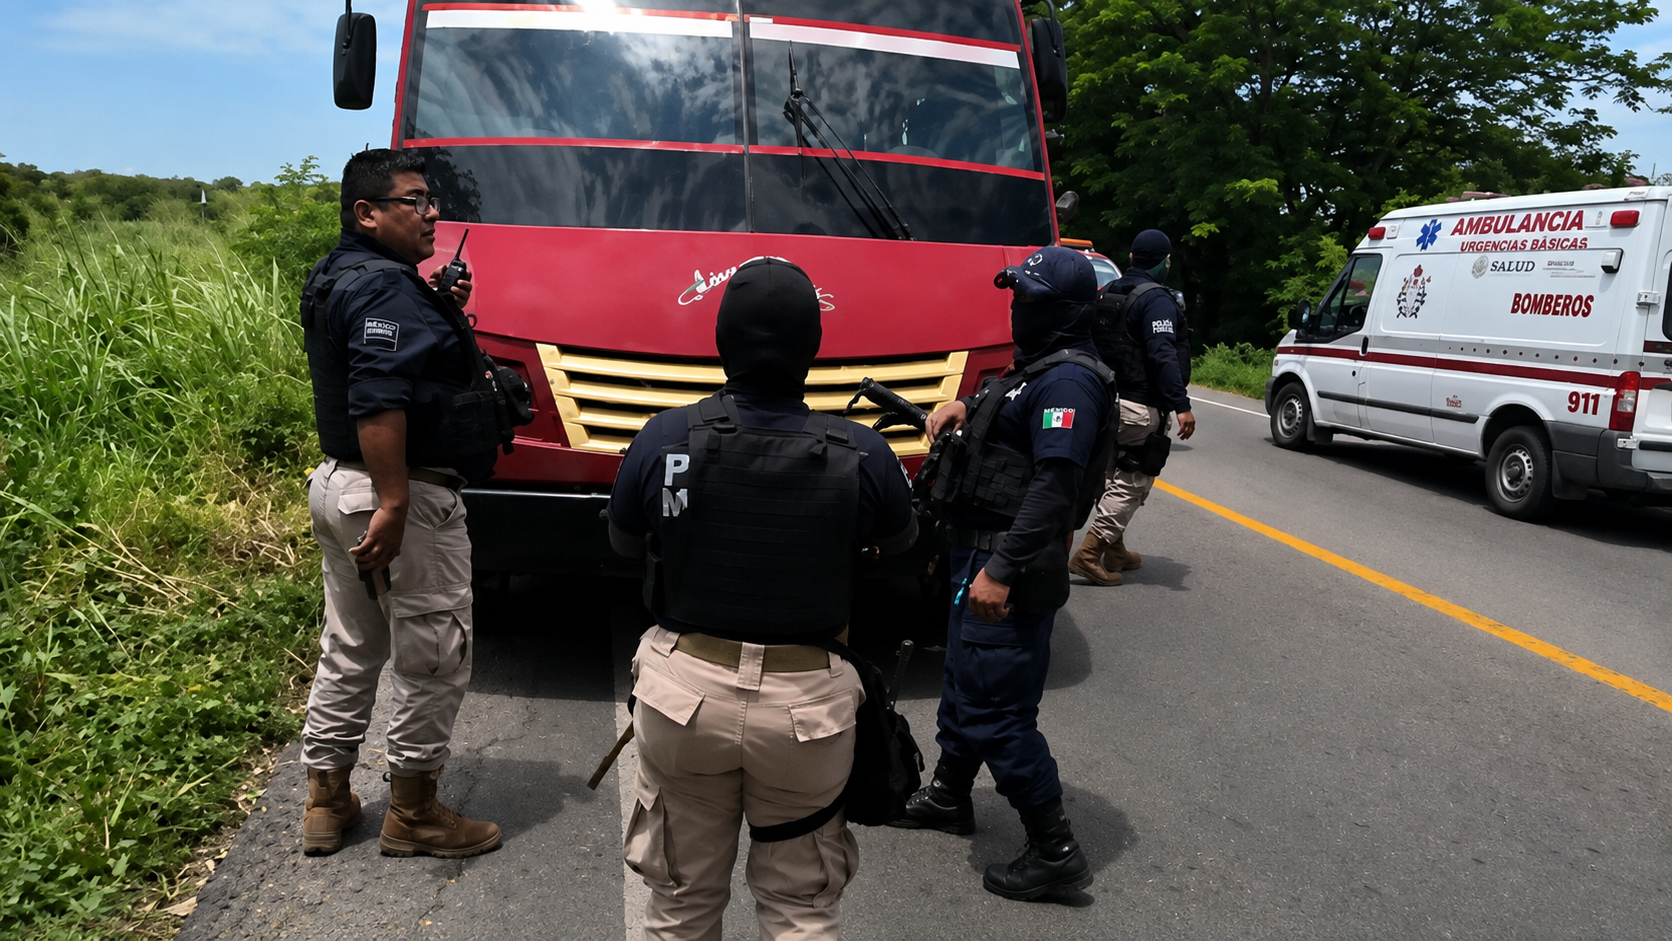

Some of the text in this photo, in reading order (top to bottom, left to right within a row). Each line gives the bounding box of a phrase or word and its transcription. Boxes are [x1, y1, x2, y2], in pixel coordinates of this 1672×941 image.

[1450, 210, 1584, 236] AMBULANCIA
[1460, 236, 1588, 252] URGENCIAS BÁSICAS
[1490, 260, 1536, 272] SALUD
[1510, 293, 1595, 318] BOMBEROS
[1567, 391, 1600, 416] 911
[664, 453, 690, 486] P
